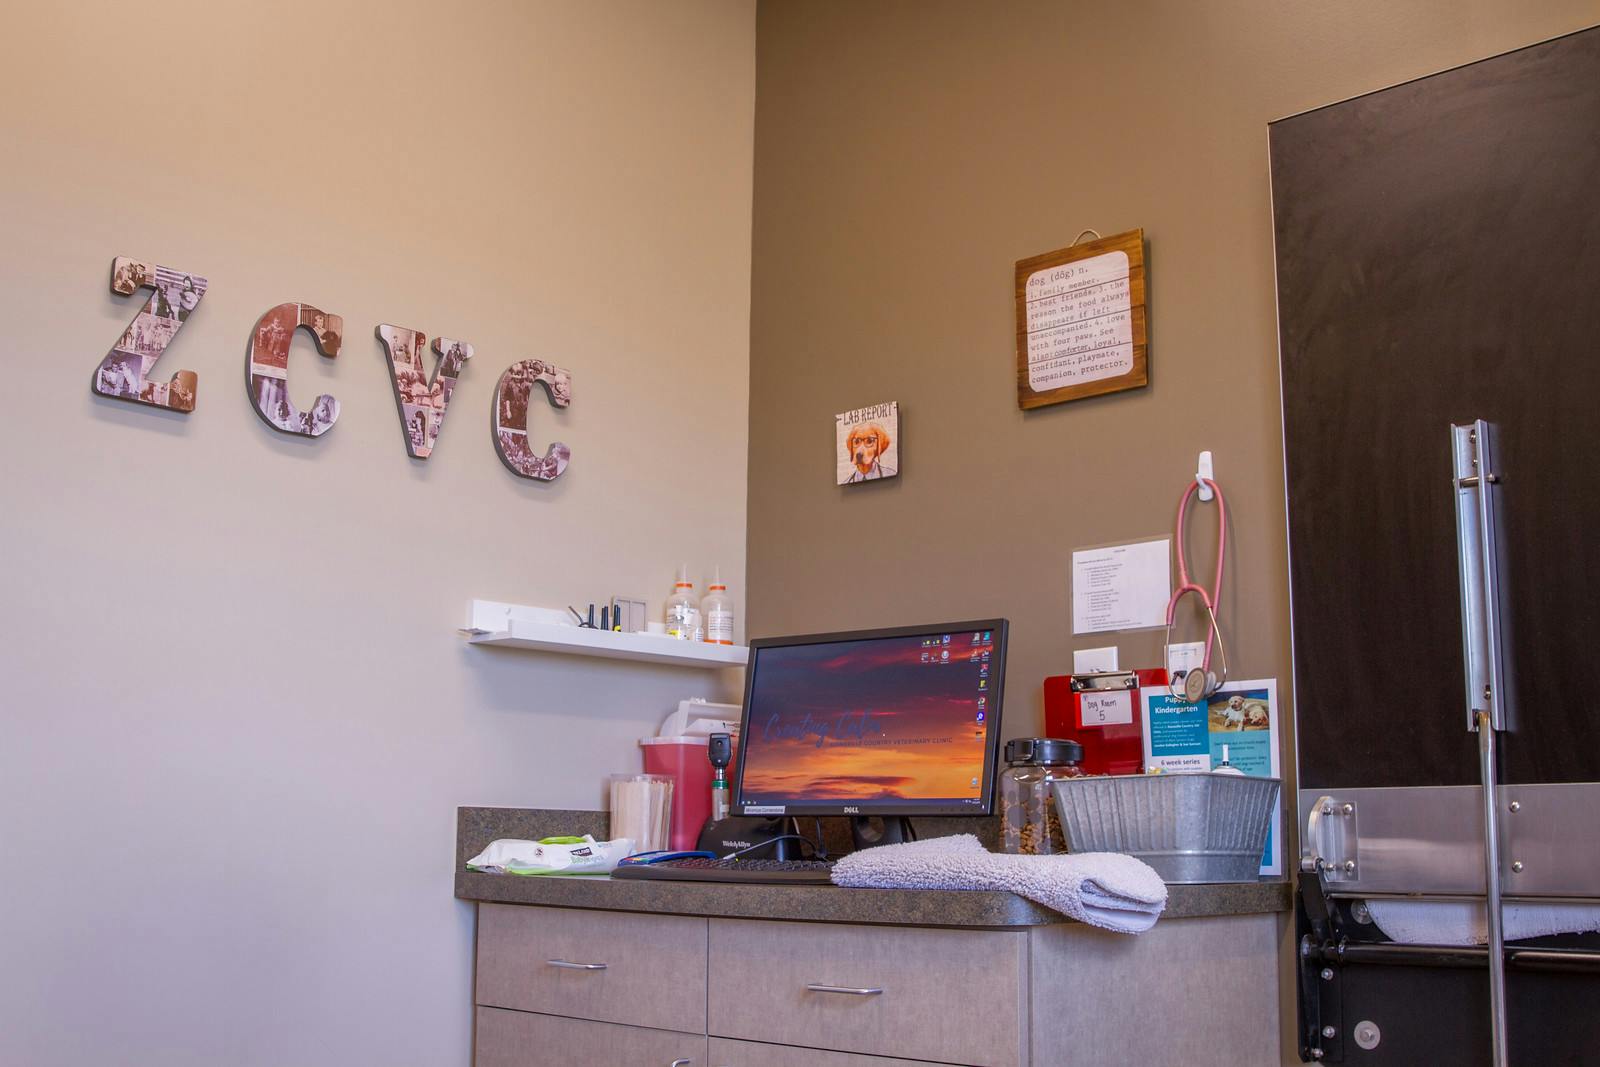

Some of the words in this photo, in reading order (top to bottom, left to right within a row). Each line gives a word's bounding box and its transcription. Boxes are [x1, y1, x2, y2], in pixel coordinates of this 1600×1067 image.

[1029, 277, 1046, 287] dog
[1078, 267, 1088, 275] n.
[1039, 284, 1065, 297] family
[1068, 278, 1100, 289] member.
[1039, 298, 1058, 308] best
[1110, 281, 1125, 290] the
[1031, 308, 1057, 320] reason
[1060, 304, 1074, 313] the
[1078, 298, 1097, 309] food
[1079, 310, 1088, 319] if
[1093, 306, 1111, 316] left
[1031, 321, 1092, 341] unaccompanied.
[1107, 314, 1126, 324] love
[1031, 342, 1049, 351] with
[1053, 337, 1070, 347] four
[1075, 331, 1097, 343] paws.
[1100, 328, 1114, 336] See
[1081, 360, 1128, 374] protector.
[843, 412, 860, 425] LAB
[862, 403, 891, 422] REPORT
[1100, 710, 1105, 720] 5
[1155, 706, 1198, 715] Kindergarten
